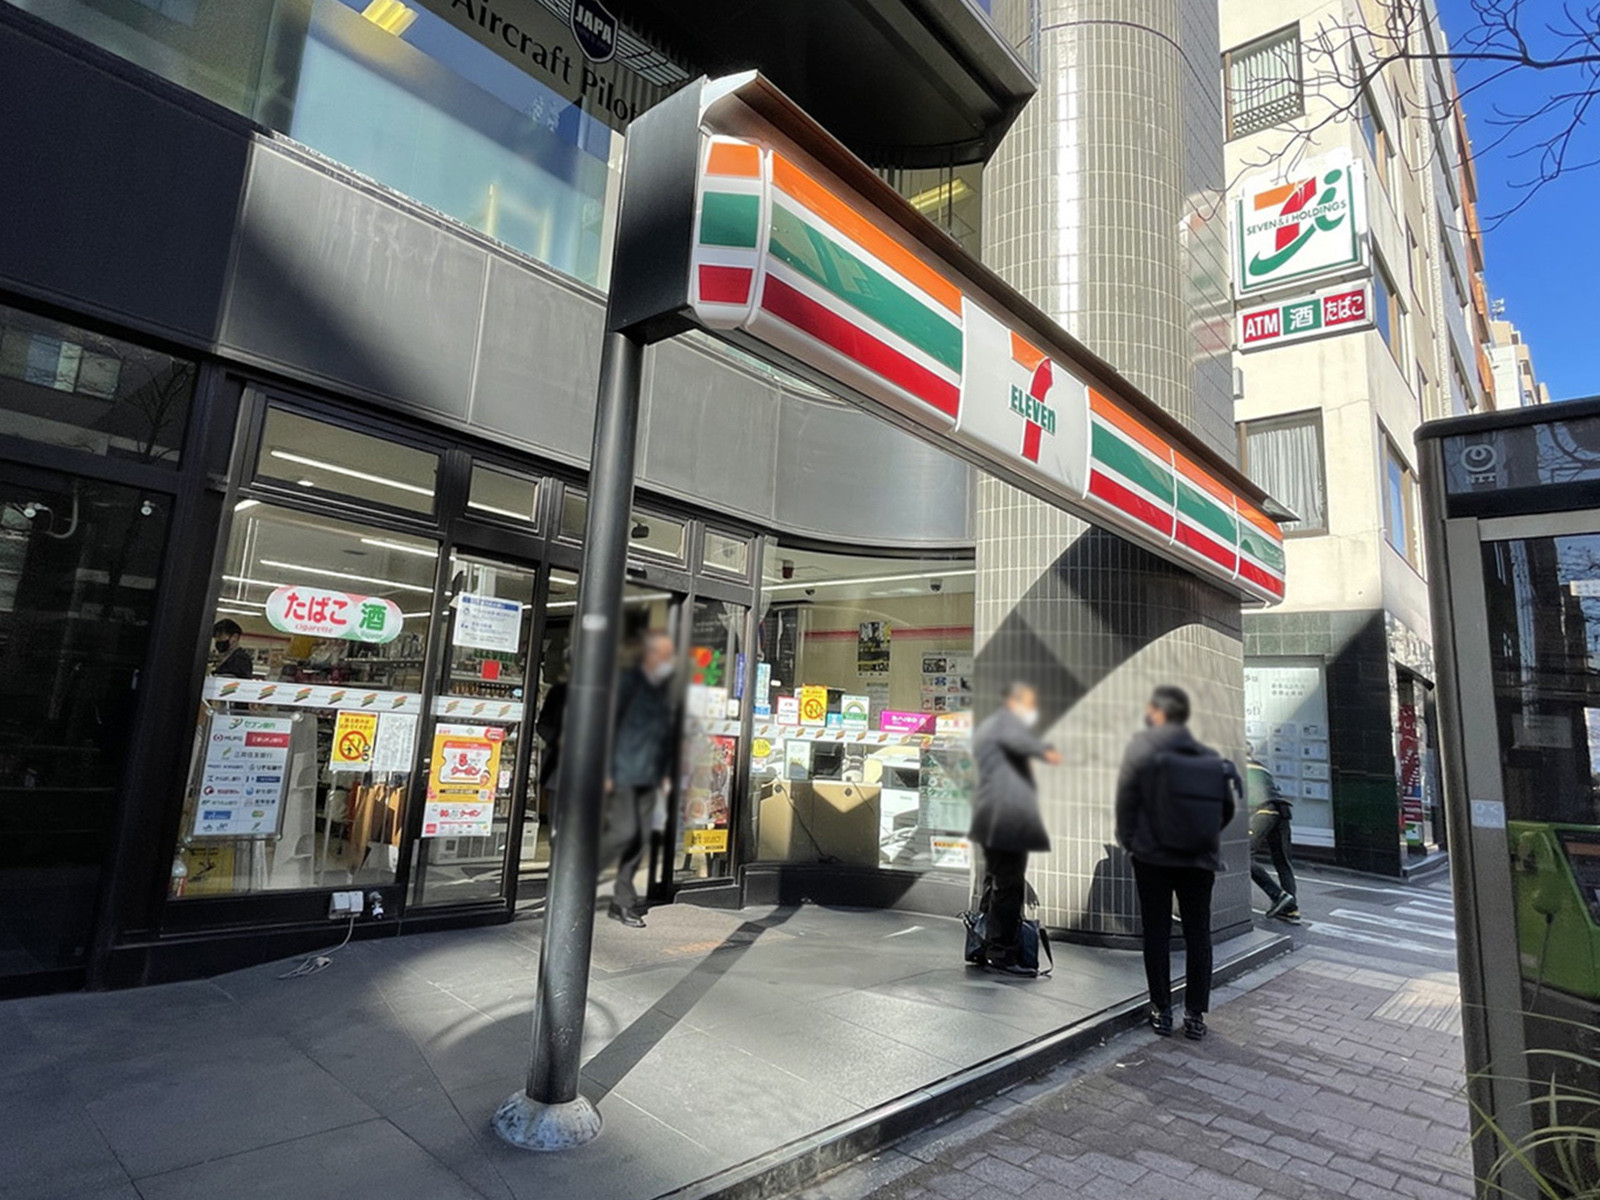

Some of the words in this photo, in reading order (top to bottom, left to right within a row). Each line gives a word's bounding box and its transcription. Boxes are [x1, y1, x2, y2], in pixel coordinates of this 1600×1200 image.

[574, 5, 613, 45] JAPA
[452, 0, 573, 85] Aircraft
[1291, 200, 1348, 224] HOLDINGS
[1289, 304, 1315, 331] 酒
[1324, 295, 1364, 322] たばこ
[1244, 313, 1280, 339] ATM
[1466, 471, 1497, 485] NTT
[283, 591, 349, 627] たばこ
[359, 602, 388, 632] 酒
